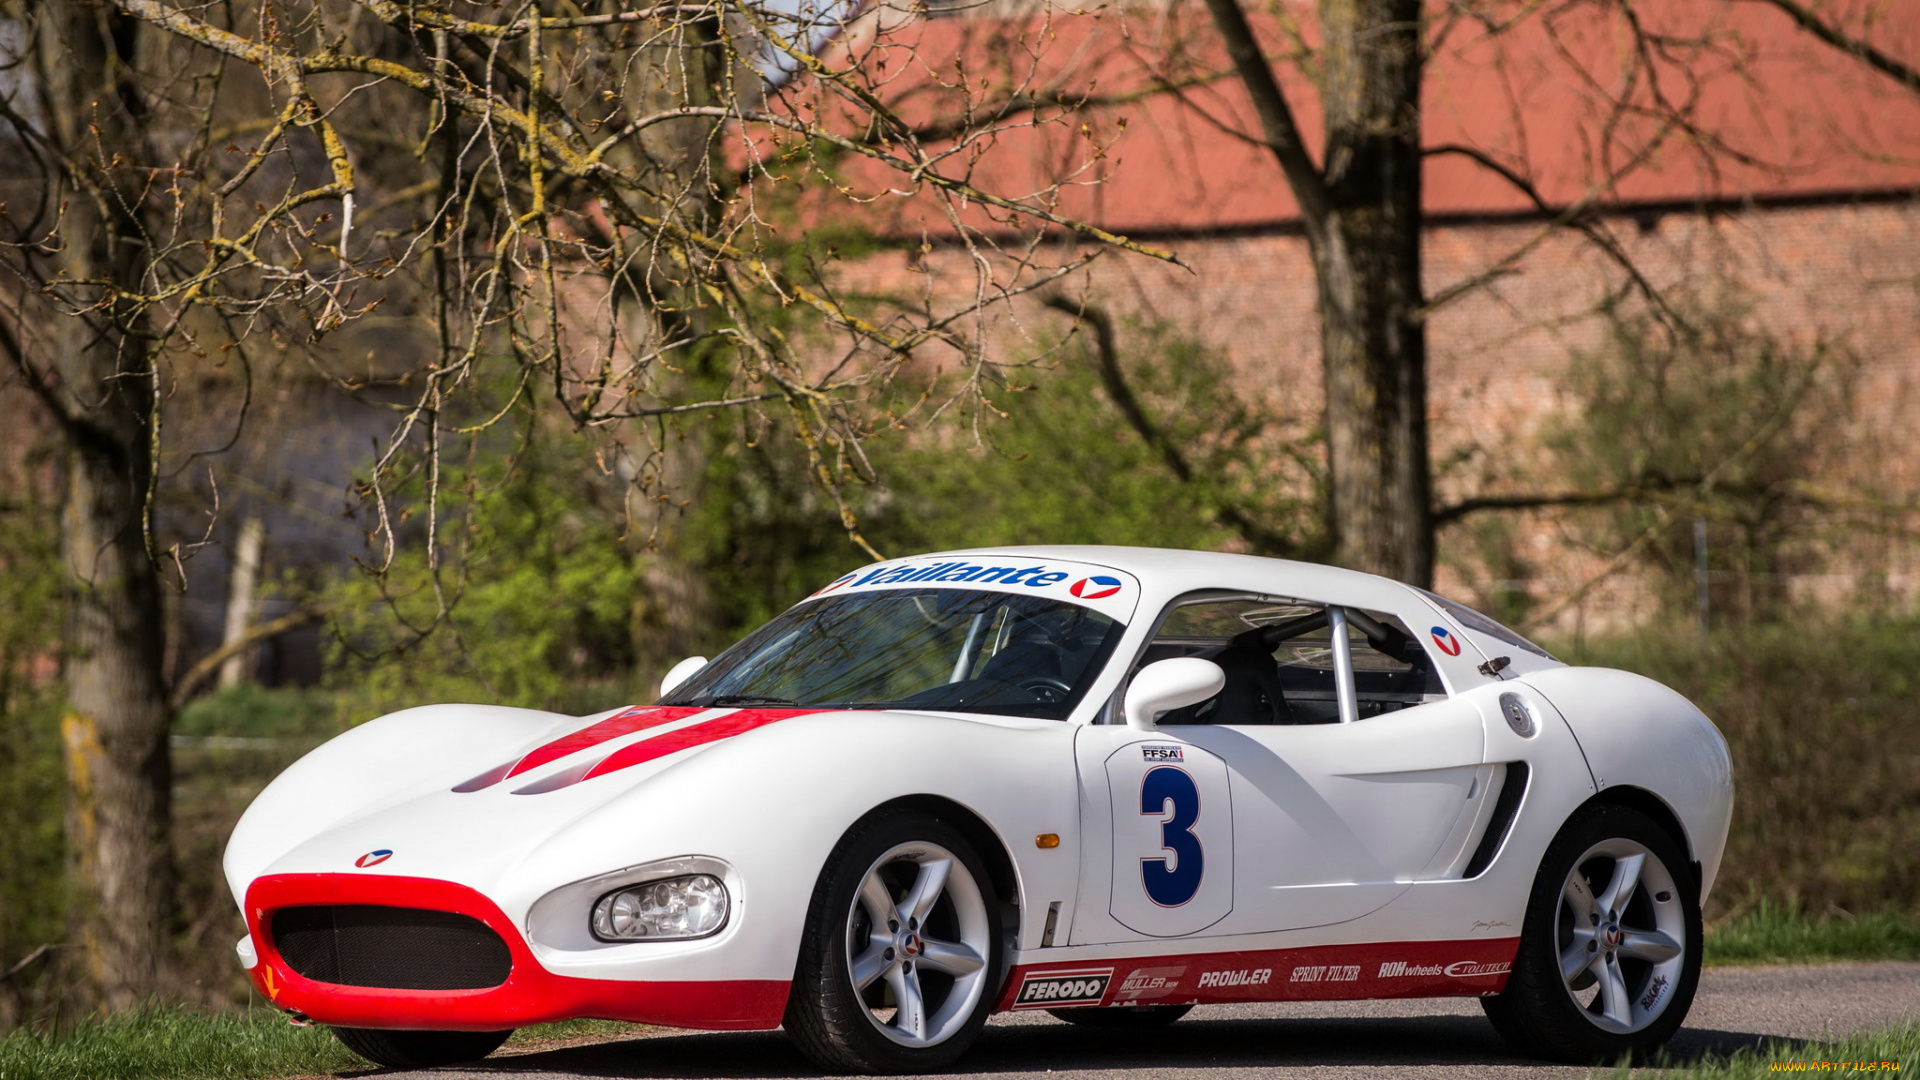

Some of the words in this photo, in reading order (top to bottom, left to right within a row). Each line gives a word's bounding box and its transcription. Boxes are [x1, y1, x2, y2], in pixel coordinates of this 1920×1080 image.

[850, 562, 1068, 588] Vaillante
[1140, 765, 1204, 908] 3
[1198, 969, 1272, 988] PROWLER
[1290, 966, 1325, 982] SPRINT
[1325, 965, 1360, 981] FILTER
[1405, 964, 1443, 976] wheels
[1024, 979, 1101, 1000] FERODO
[1119, 977, 1166, 990] MULLER
